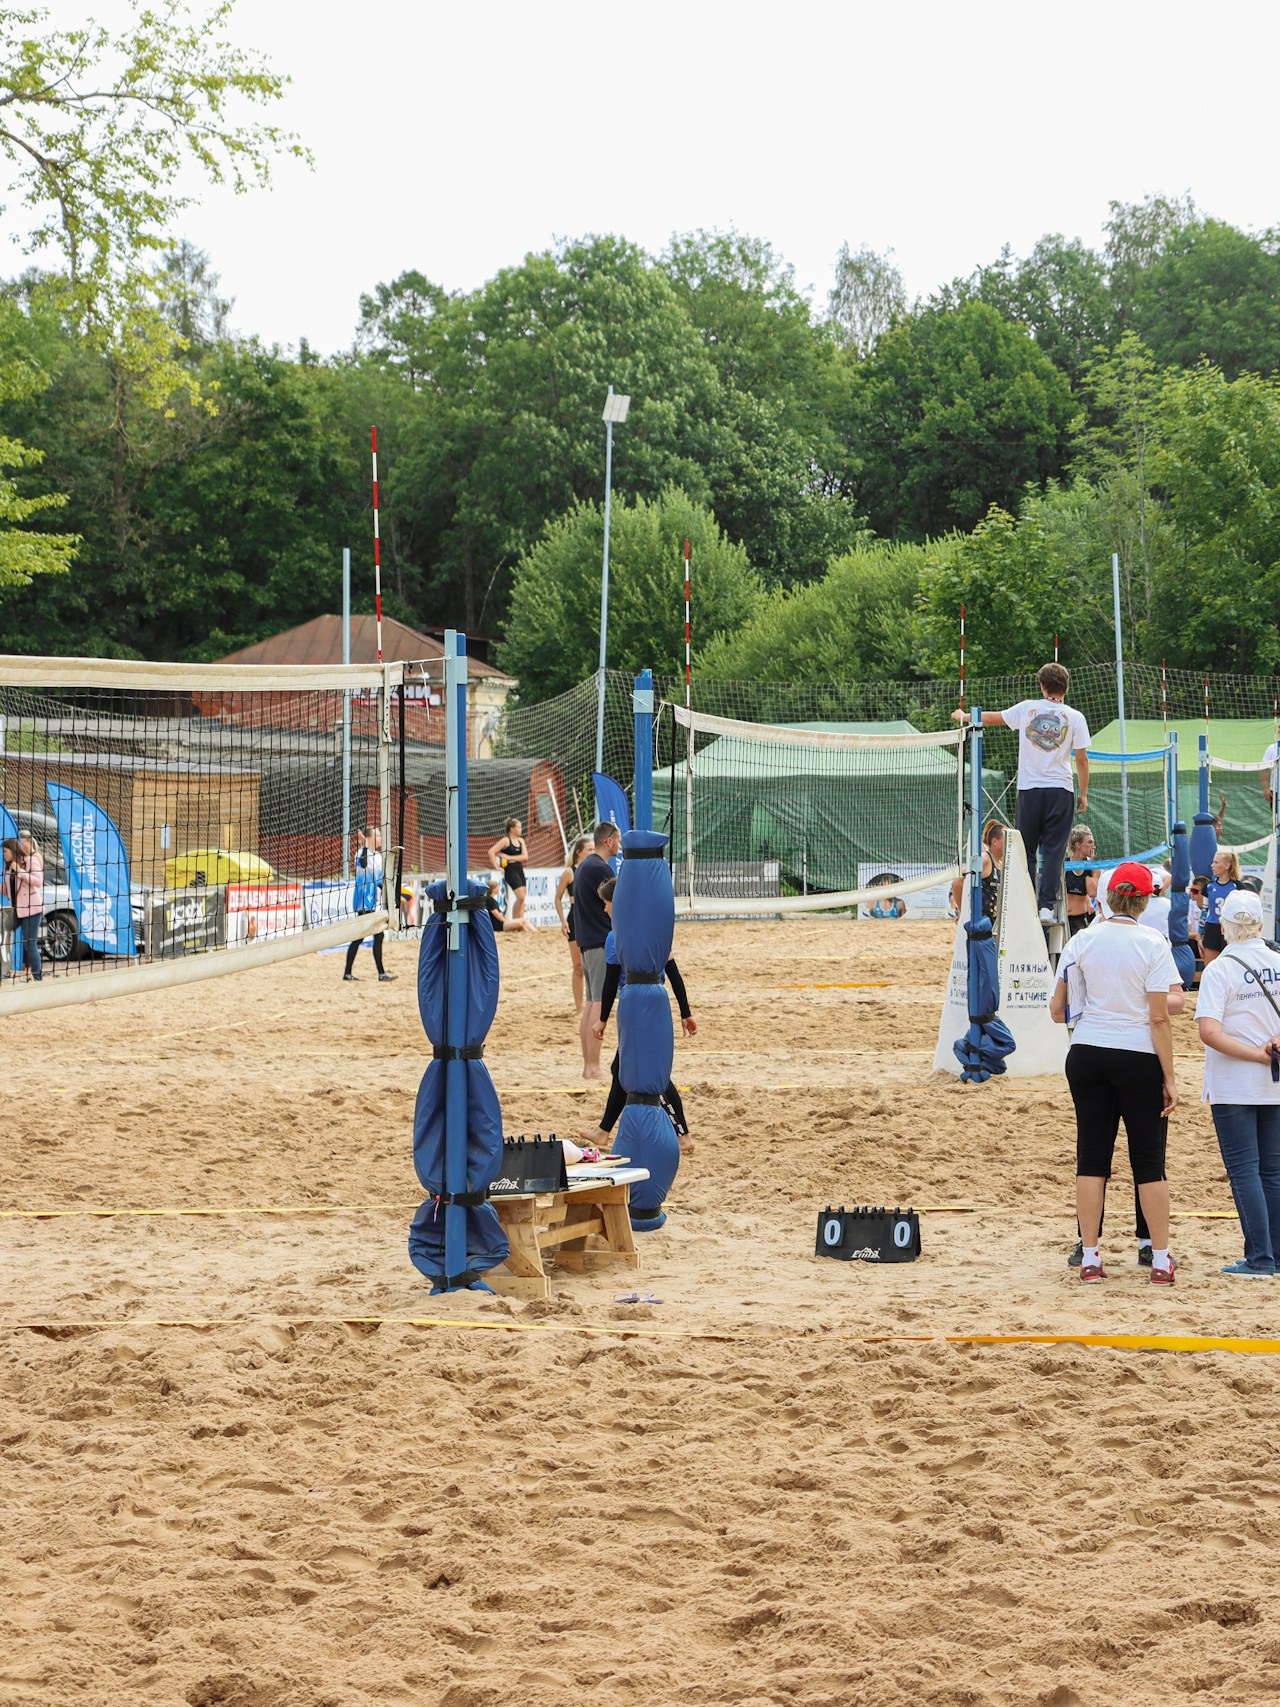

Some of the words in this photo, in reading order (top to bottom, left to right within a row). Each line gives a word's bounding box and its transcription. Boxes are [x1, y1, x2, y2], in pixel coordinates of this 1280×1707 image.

[1009, 963, 1048, 973] ПЛЯЖНЫЙ
[1015, 992, 1047, 1001] ГАТЧИНЕ
[824, 1219, 841, 1246] 0
[893, 1221, 911, 1248] 0
